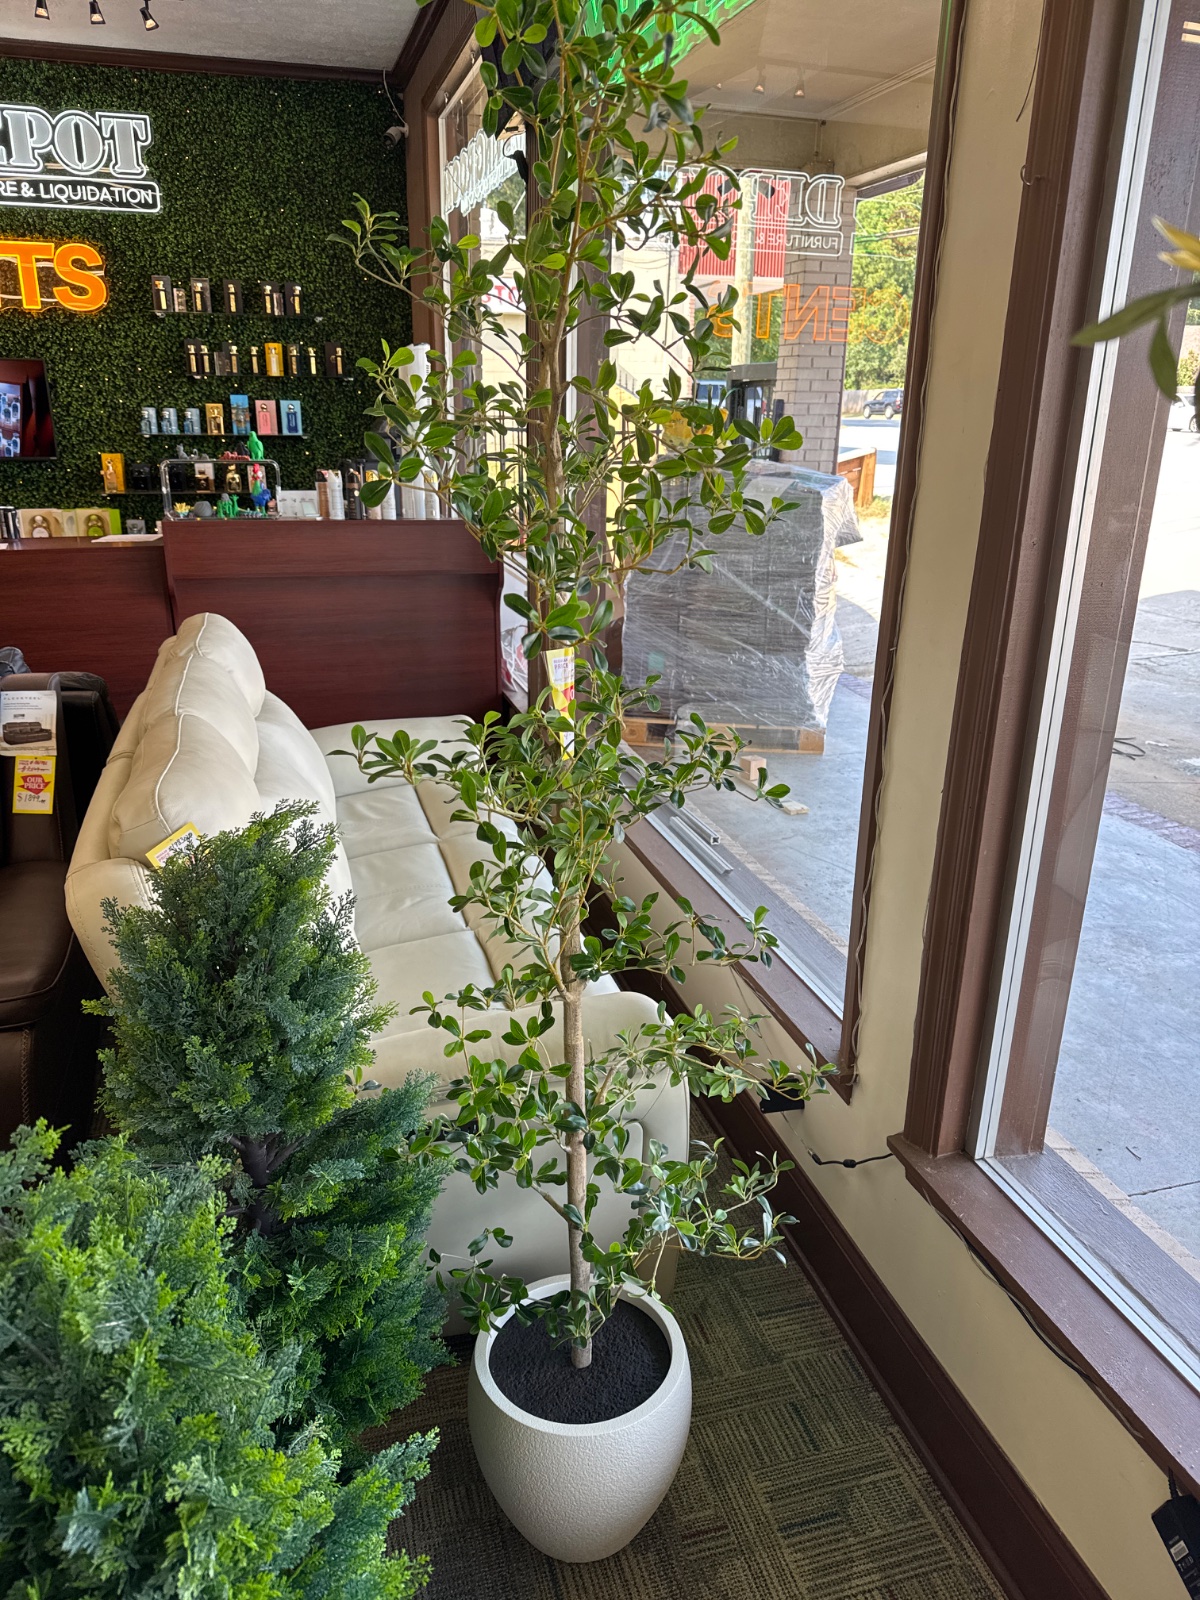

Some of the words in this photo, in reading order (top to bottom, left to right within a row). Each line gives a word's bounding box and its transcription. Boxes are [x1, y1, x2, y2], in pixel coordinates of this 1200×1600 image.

[0, 106, 150, 178] POT
[20, 181, 36, 197] &
[39, 183, 153, 204] LIQUIDATION
[24, 782, 46, 790] PRICE
[26, 776, 43, 784] OUR
